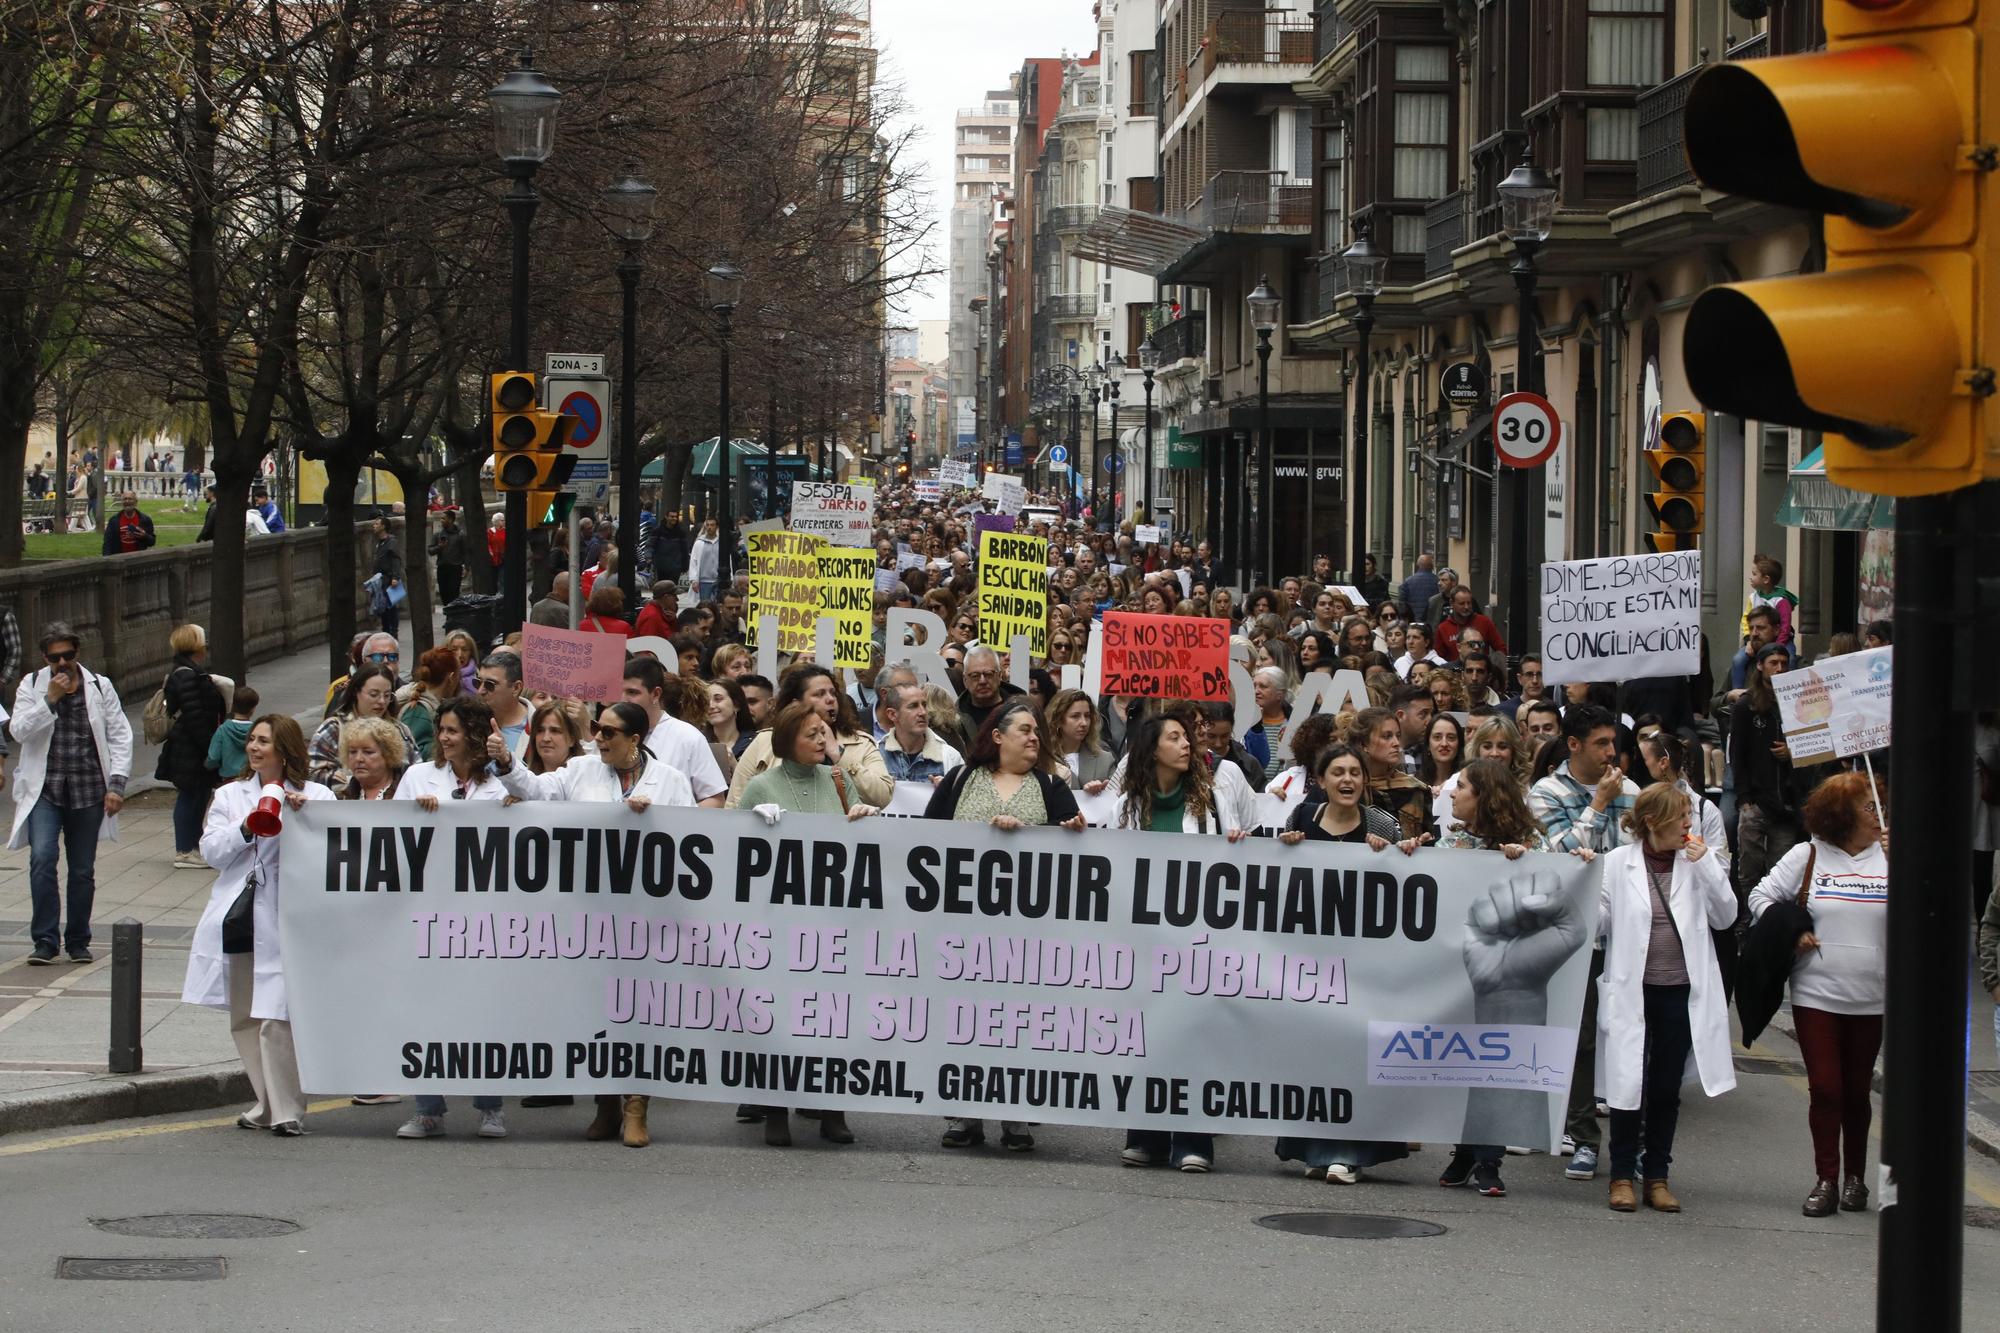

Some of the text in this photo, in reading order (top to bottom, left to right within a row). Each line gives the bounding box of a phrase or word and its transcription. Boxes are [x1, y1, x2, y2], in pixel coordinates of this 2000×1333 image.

[551, 360, 580, 370] ZONA
[591, 362, 598, 371] 3
[1450, 390, 1478, 398] CENTRO
[1501, 417, 1545, 443] 30
[1275, 466, 1342, 480] www. grup
[798, 483, 852, 500] SESPA
[793, 519, 844, 529] ENFERMERAS
[989, 537, 1045, 565] BARBÓN
[750, 554, 820, 580] ENGAÑADO
[818, 557, 875, 580] RECORTAD
[983, 564, 1047, 593] ESCUCHA
[750, 579, 821, 606] SILENCIADO
[819, 582, 872, 612] SILLONES
[1625, 584, 1675, 614] ESTÁ
[982, 593, 1043, 620] SANIDAD
[839, 619, 863, 636] NO
[980, 618, 1000, 646] EN
[1134, 624, 1157, 647] NO
[1161, 623, 1225, 649] SABES
[527, 635, 593, 655] NUESTROS
[526, 648, 592, 670] DERECHOS
[526, 662, 571, 681] NO SON
[1106, 649, 1201, 673] MANDAR,
[1164, 675, 1192, 697] HAS
[1774, 680, 1808, 694] TRABAJAR
[1825, 672, 1846, 682] SESPA
[1792, 687, 1823, 699] INFIERNO
[1844, 745, 1858, 754] SIN
[326, 826, 1438, 942] HAY MOTIVOS PARA SEGUIR LUCHANDO
[411, 911, 1349, 1005] TRABAJADORXS DE LA SANIDAD PÚBLICA
[604, 976, 1147, 1059] UNIDXS EN SU DEFENSA
[1381, 1025, 1511, 1061] ATAS
[401, 1030, 1353, 1125] SANIDAD PÚBLICA UNIVERSAL, GRATUITA Y DE CALIDAD
